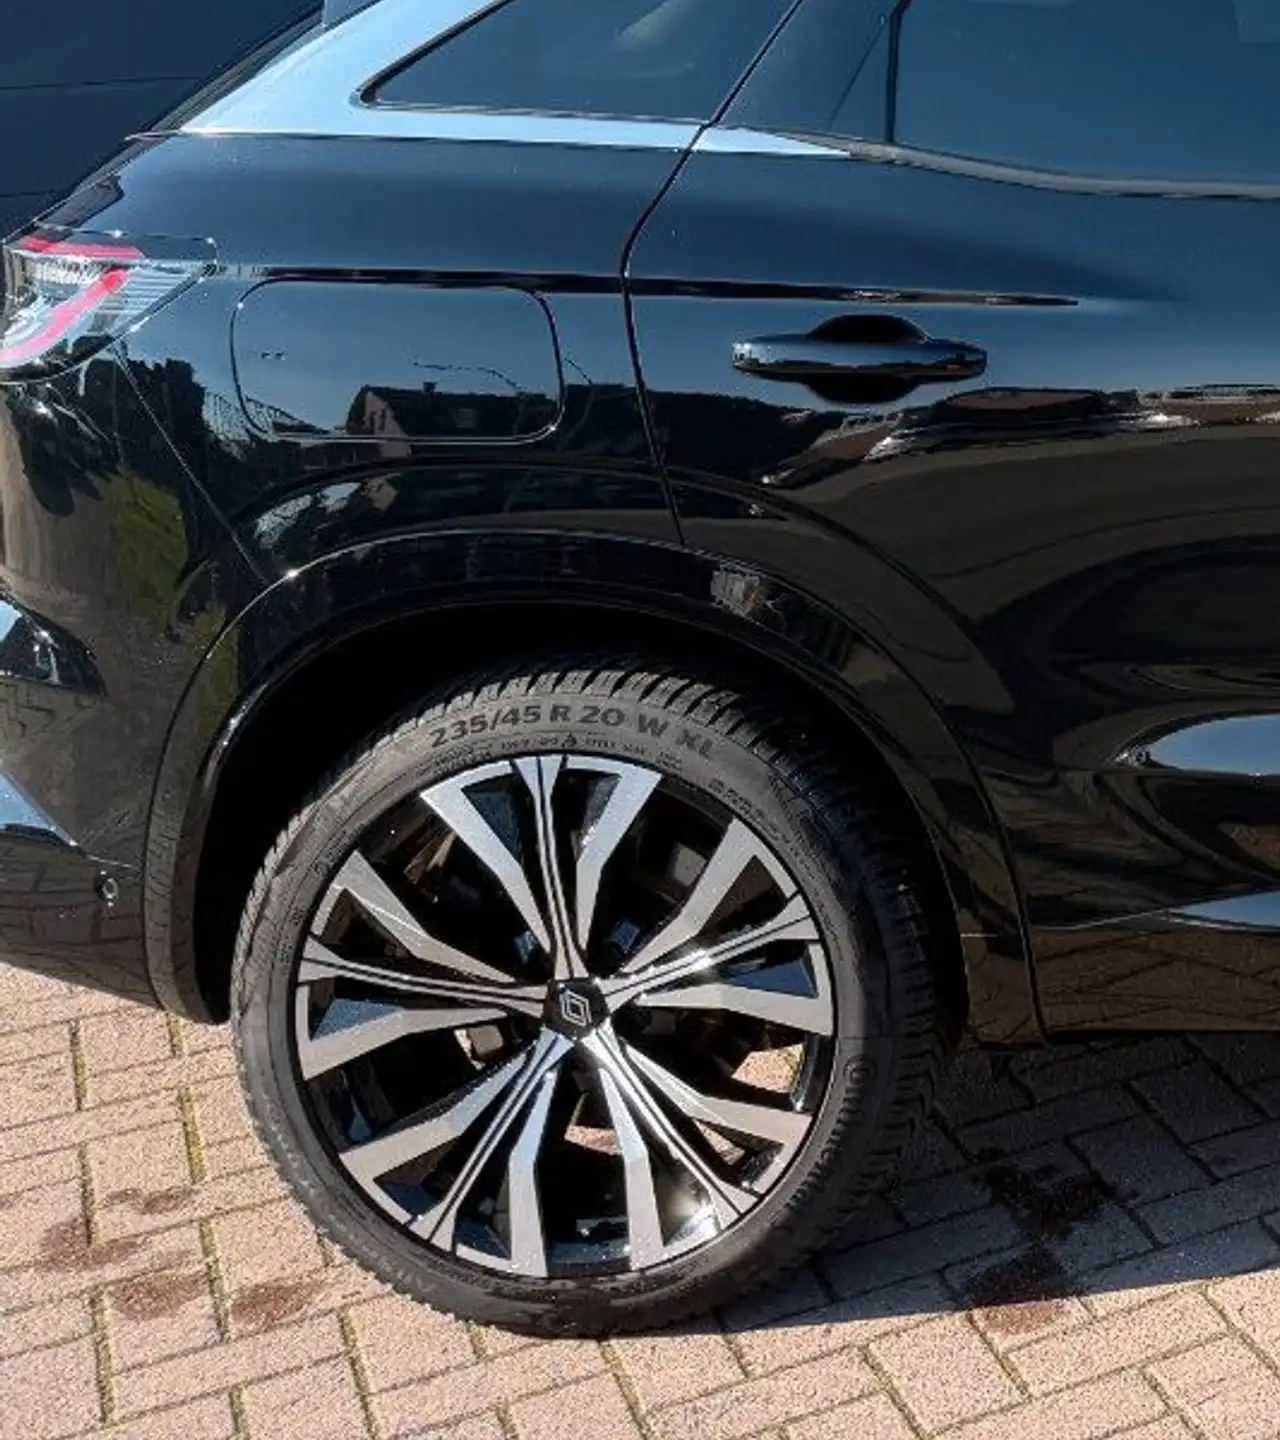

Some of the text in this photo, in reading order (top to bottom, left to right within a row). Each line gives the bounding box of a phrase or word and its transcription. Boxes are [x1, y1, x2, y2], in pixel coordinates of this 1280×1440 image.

[430, 704, 542, 749] 235/45
[549, 705, 571, 723] R
[578, 706, 626, 729] 20
[637, 714, 669, 738] W
[675, 728, 714, 761] XL
